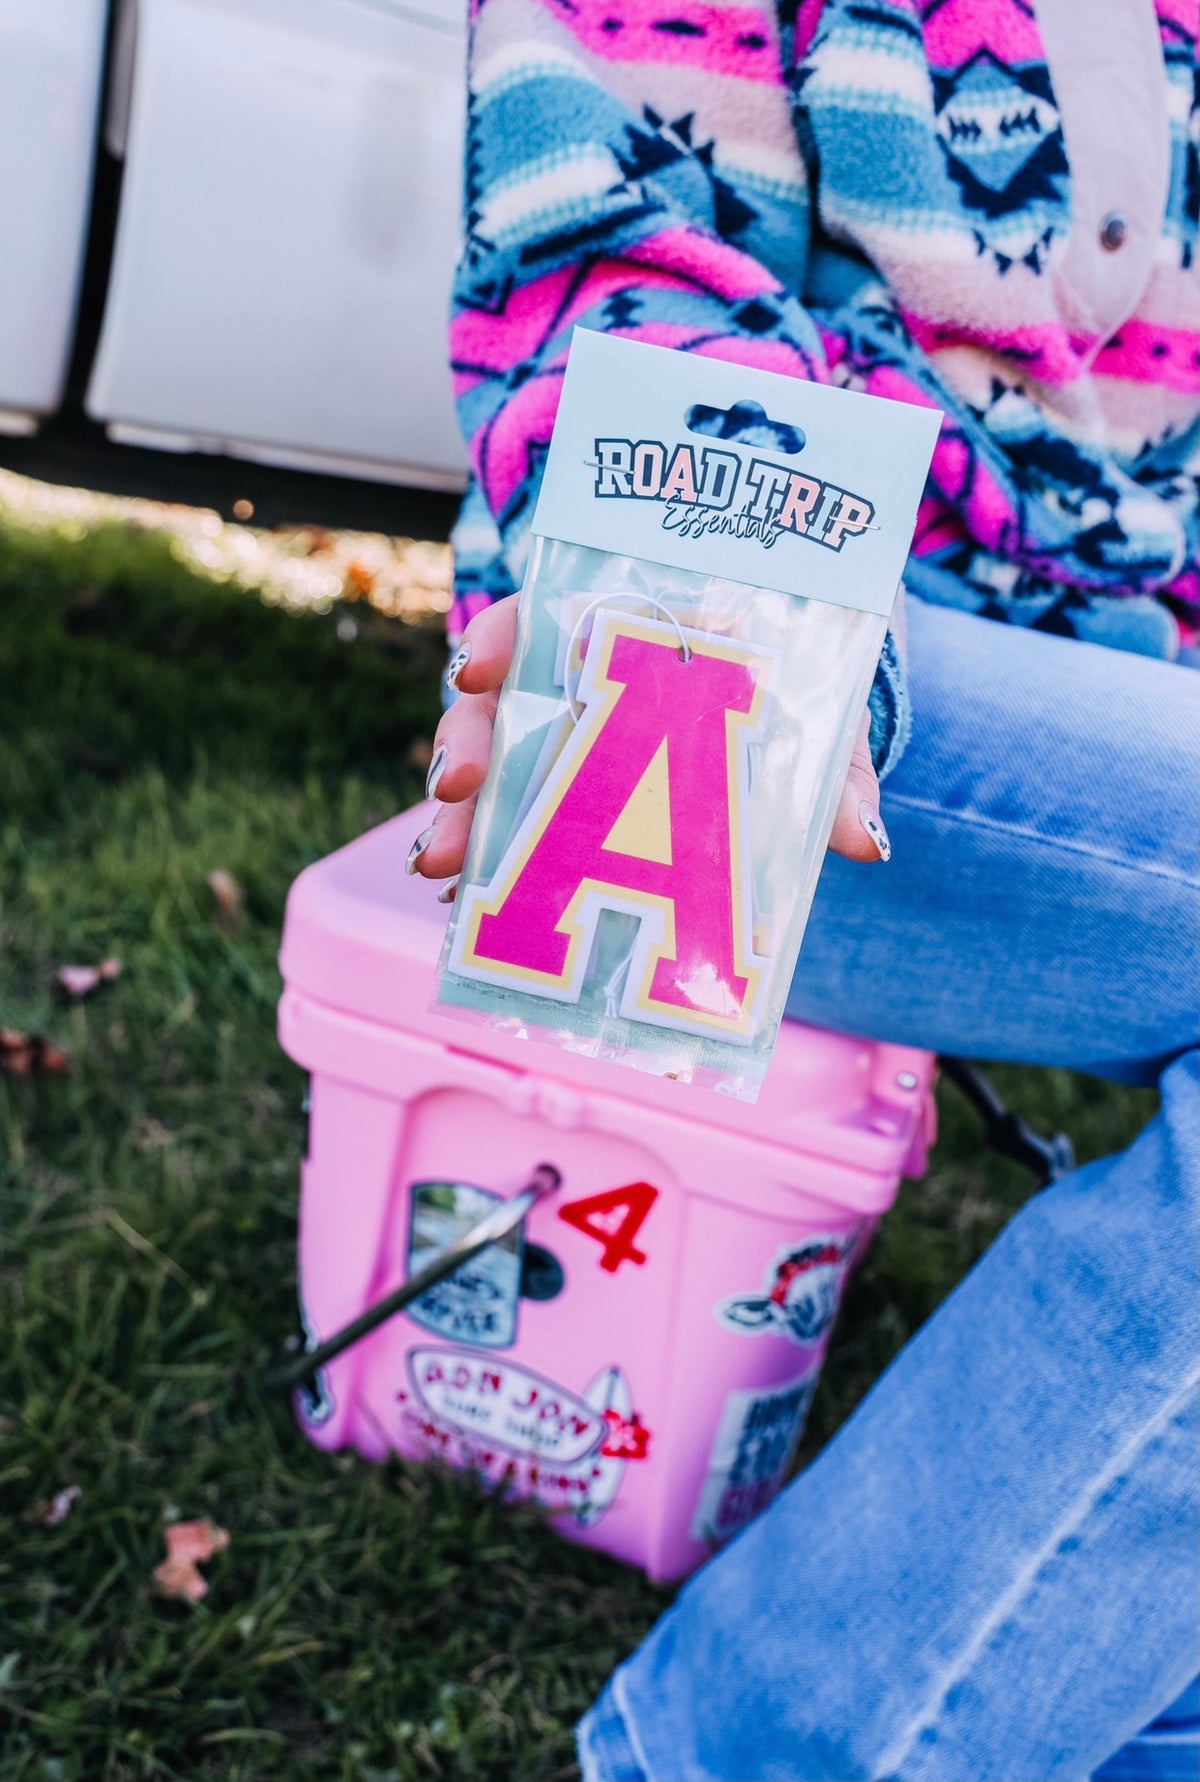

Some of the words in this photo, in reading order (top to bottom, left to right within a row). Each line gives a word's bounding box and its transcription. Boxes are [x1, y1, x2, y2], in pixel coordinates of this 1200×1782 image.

[594, 438, 742, 512] ROAD
[745, 457, 876, 553] TRIP
[661, 493, 785, 549] Essentials
[461, 620, 773, 1034] A
[557, 1181, 659, 1274] 4
